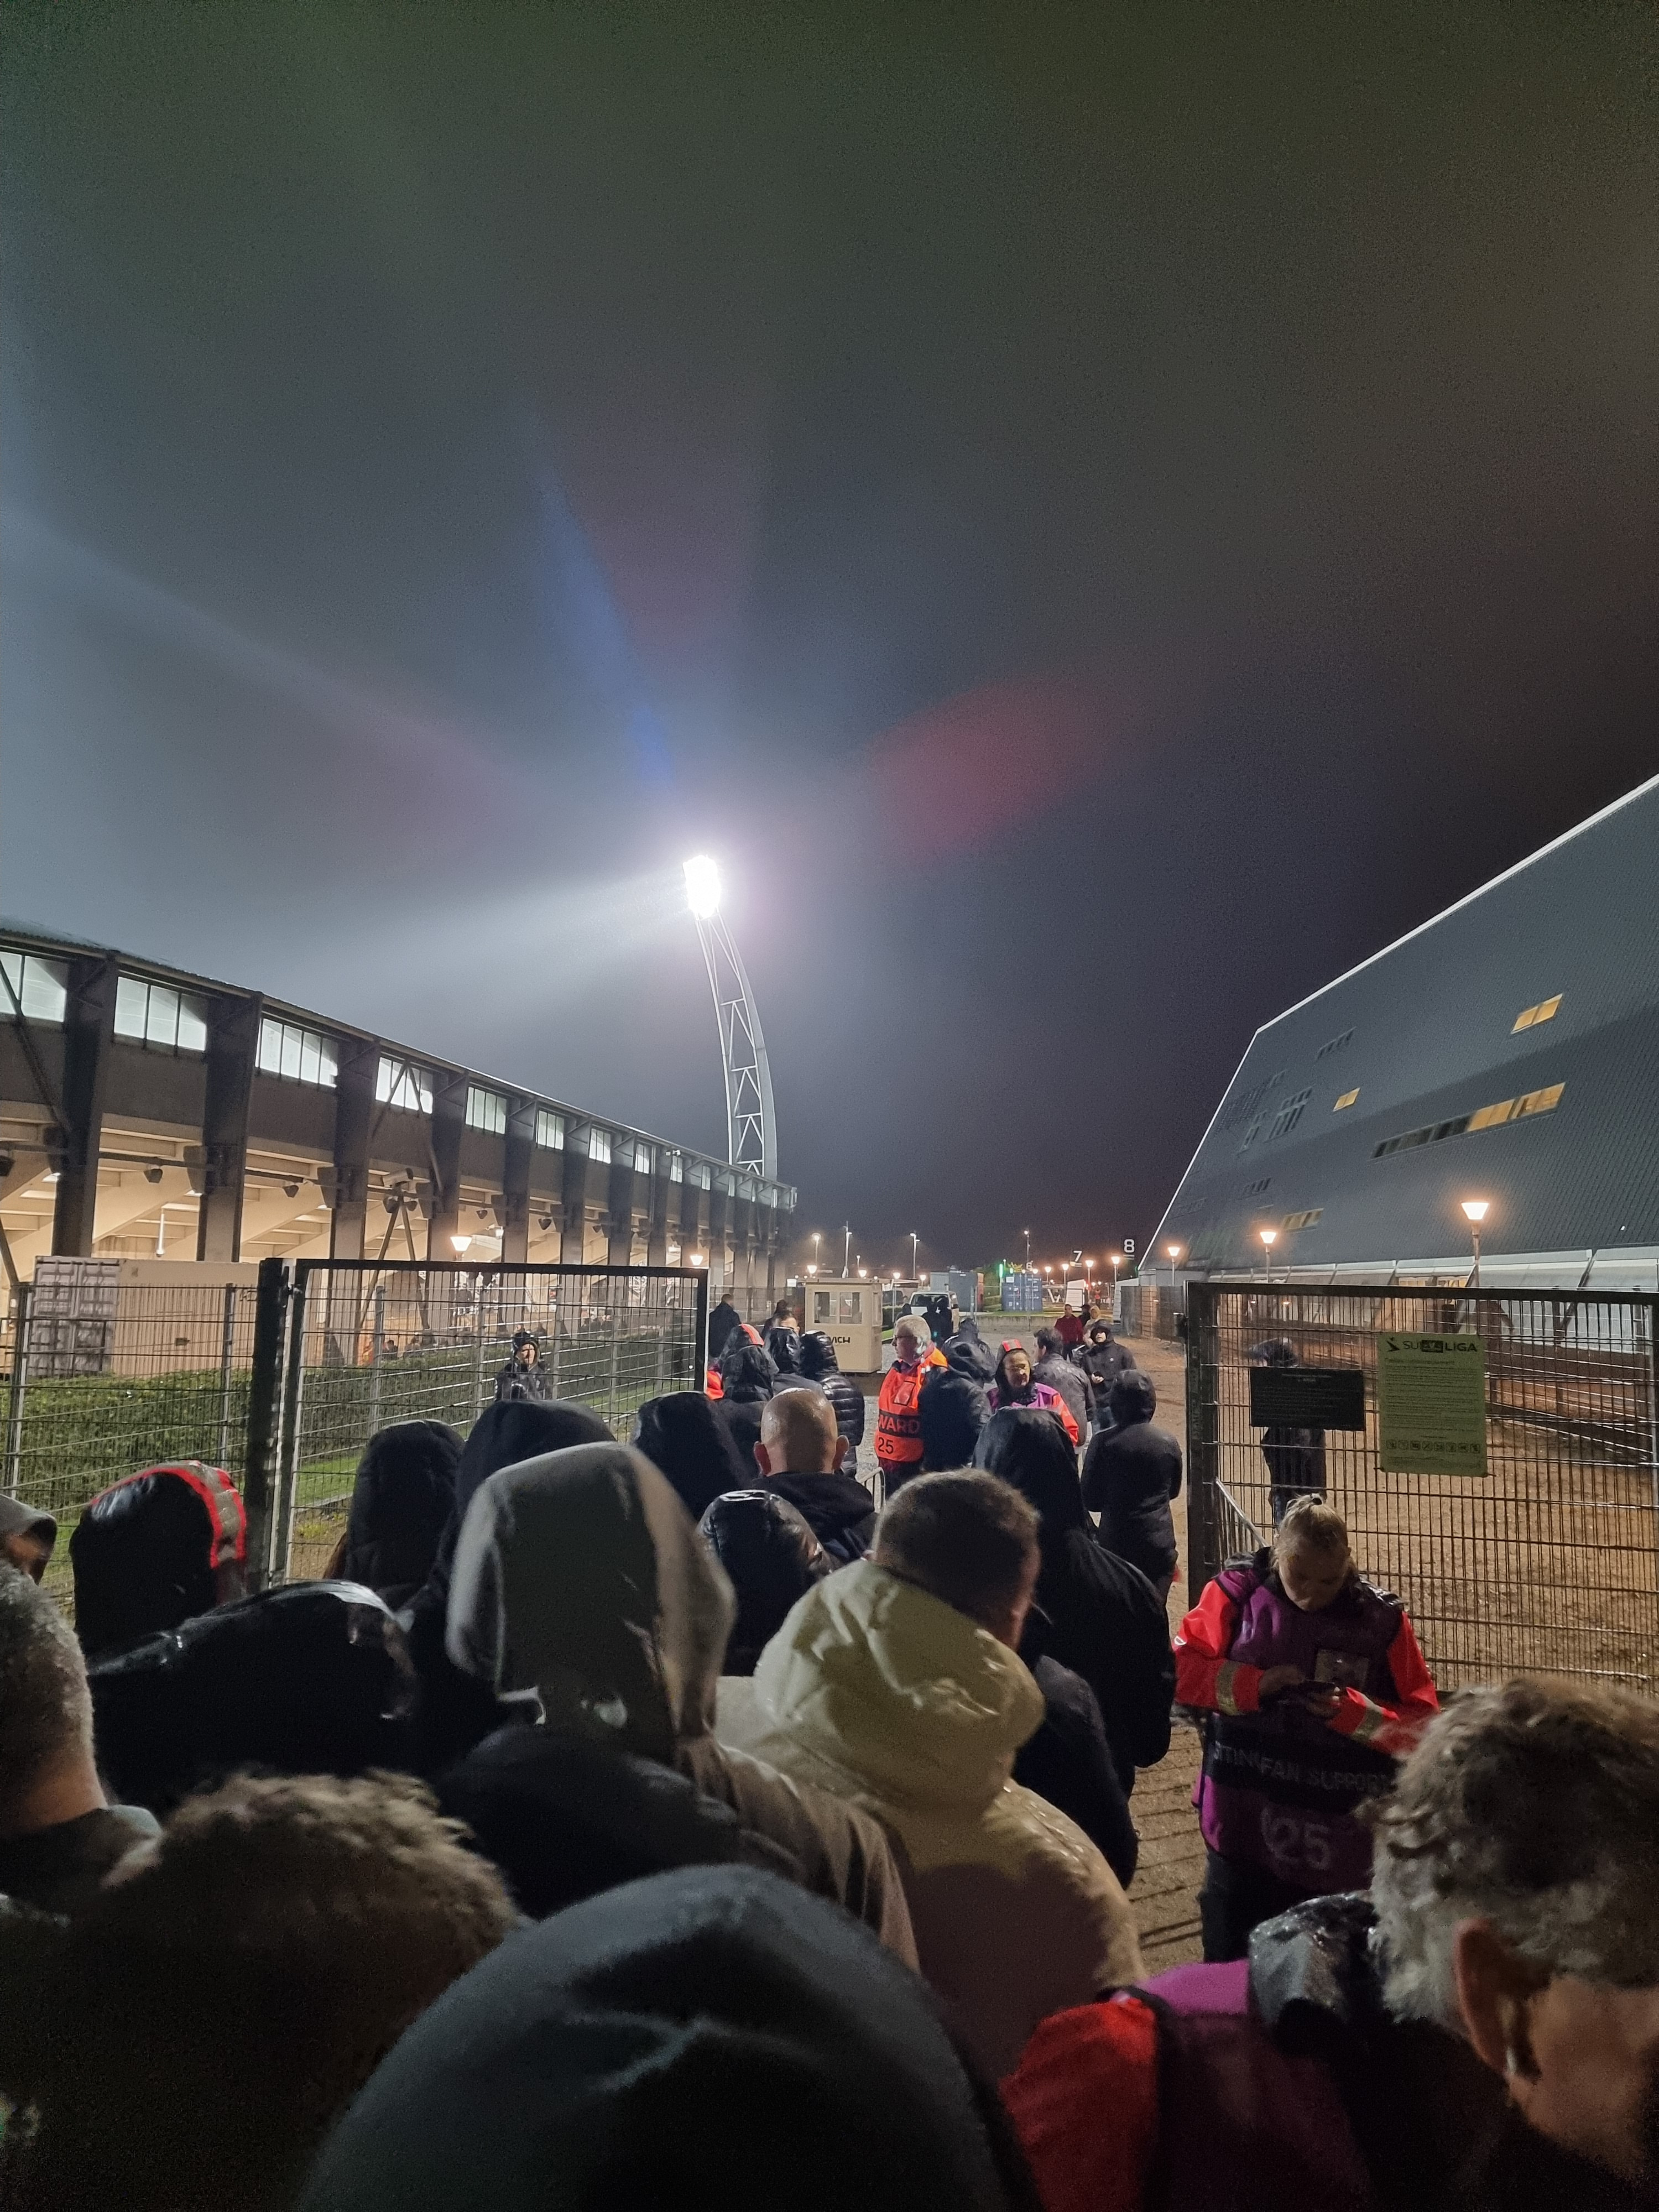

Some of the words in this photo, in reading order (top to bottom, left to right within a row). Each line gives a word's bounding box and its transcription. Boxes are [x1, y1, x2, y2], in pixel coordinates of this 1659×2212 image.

[1124, 1239, 1135, 1253] 8
[1073, 1250, 1082, 1262] 7
[1402, 1340, 1478, 1353] SULIGA
